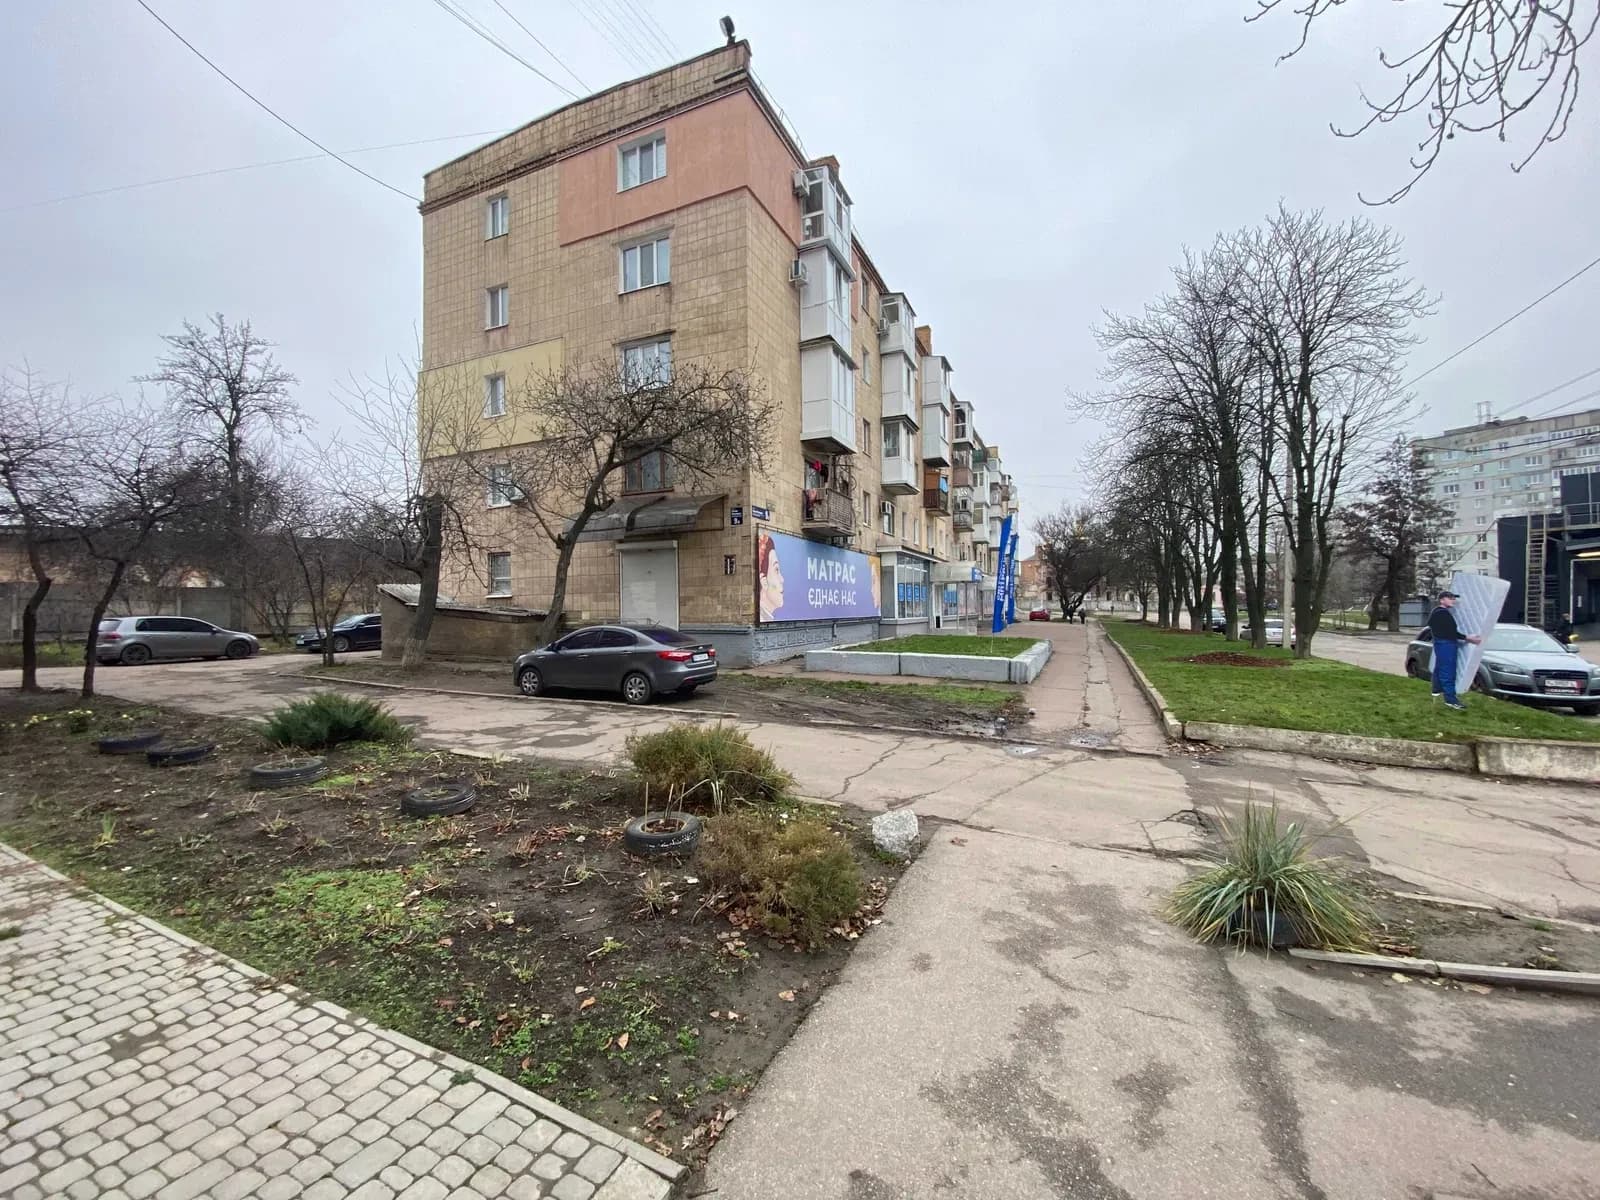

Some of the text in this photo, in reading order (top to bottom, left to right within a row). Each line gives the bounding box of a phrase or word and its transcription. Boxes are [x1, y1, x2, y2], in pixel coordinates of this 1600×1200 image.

[807, 556, 857, 585] МАТРАС
[808, 587, 857, 609] ЄДНАЄ НАС
